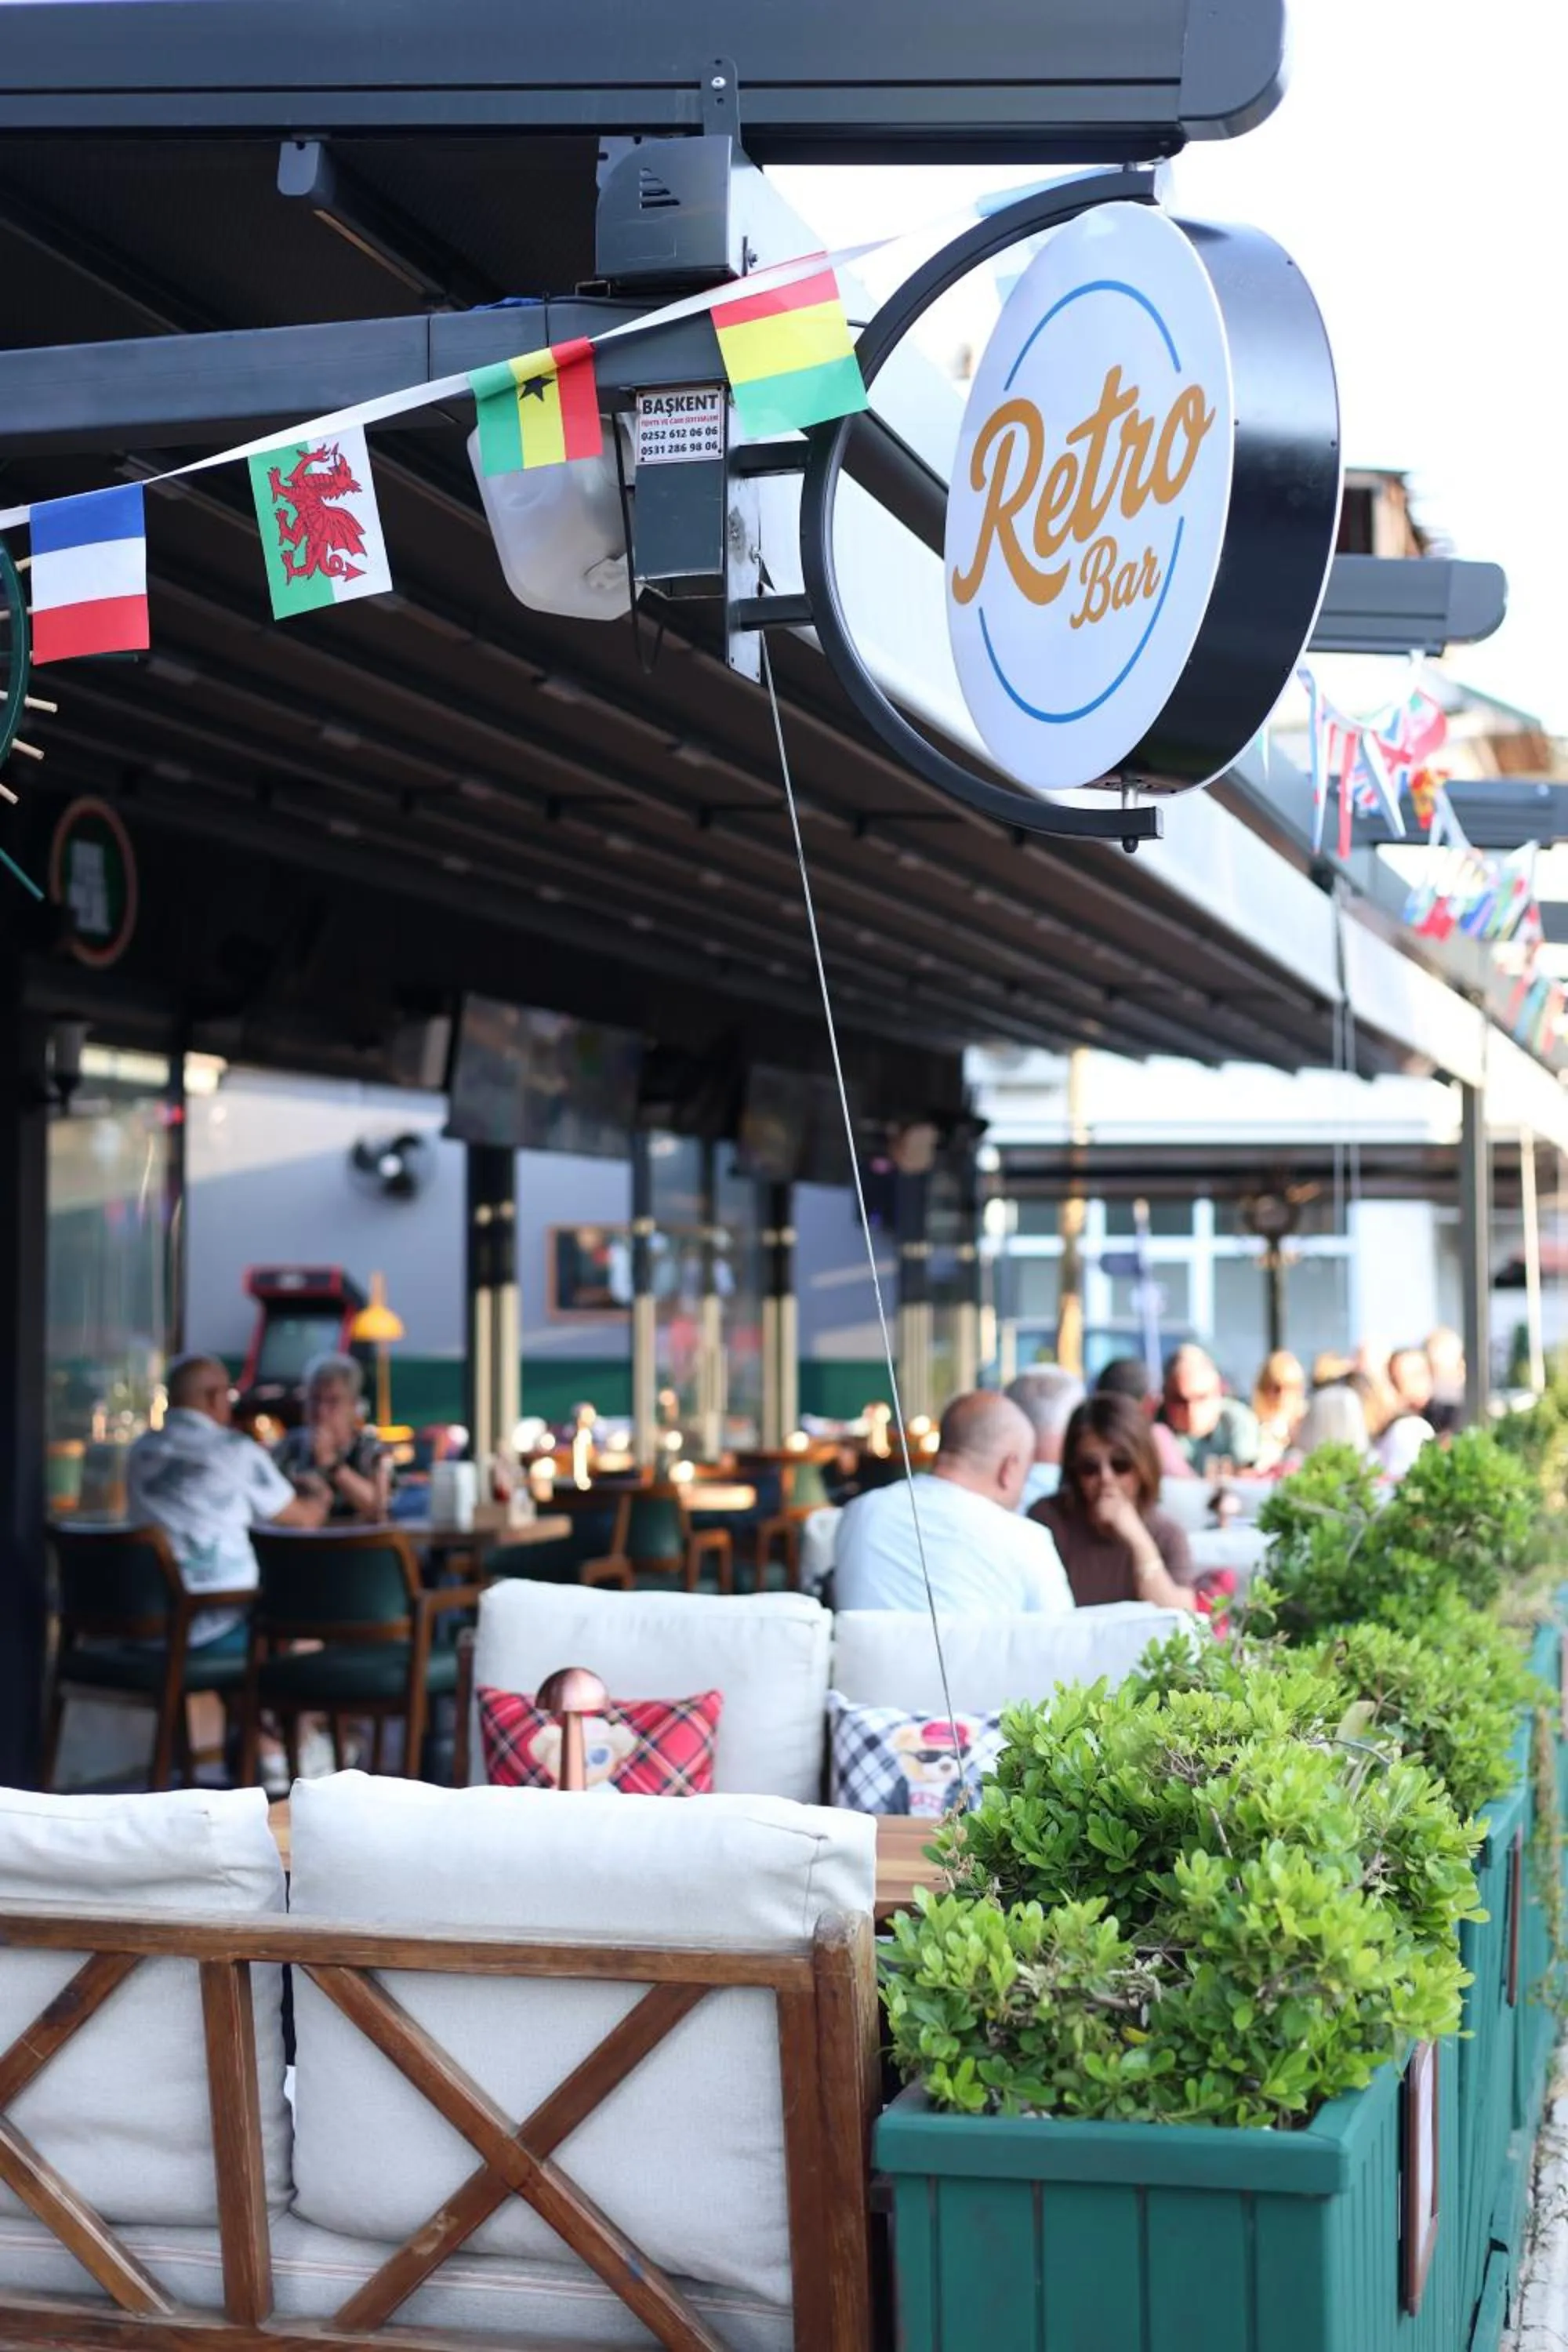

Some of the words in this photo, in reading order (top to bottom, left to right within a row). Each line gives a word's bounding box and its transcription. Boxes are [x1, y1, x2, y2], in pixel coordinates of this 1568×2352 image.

[642, 394, 718, 417] BAŞKENT
[641, 431, 666, 441] 0252
[669, 429, 688, 438] 612
[689, 427, 702, 437] 06
[705, 426, 718, 436] 06
[641, 445, 665, 456] 0531
[668, 443, 687, 453] 286
[689, 442, 702, 452] 98
[705, 441, 718, 451] 06
[951, 364, 1216, 606] Retro
[1069, 534, 1161, 630] Bar
